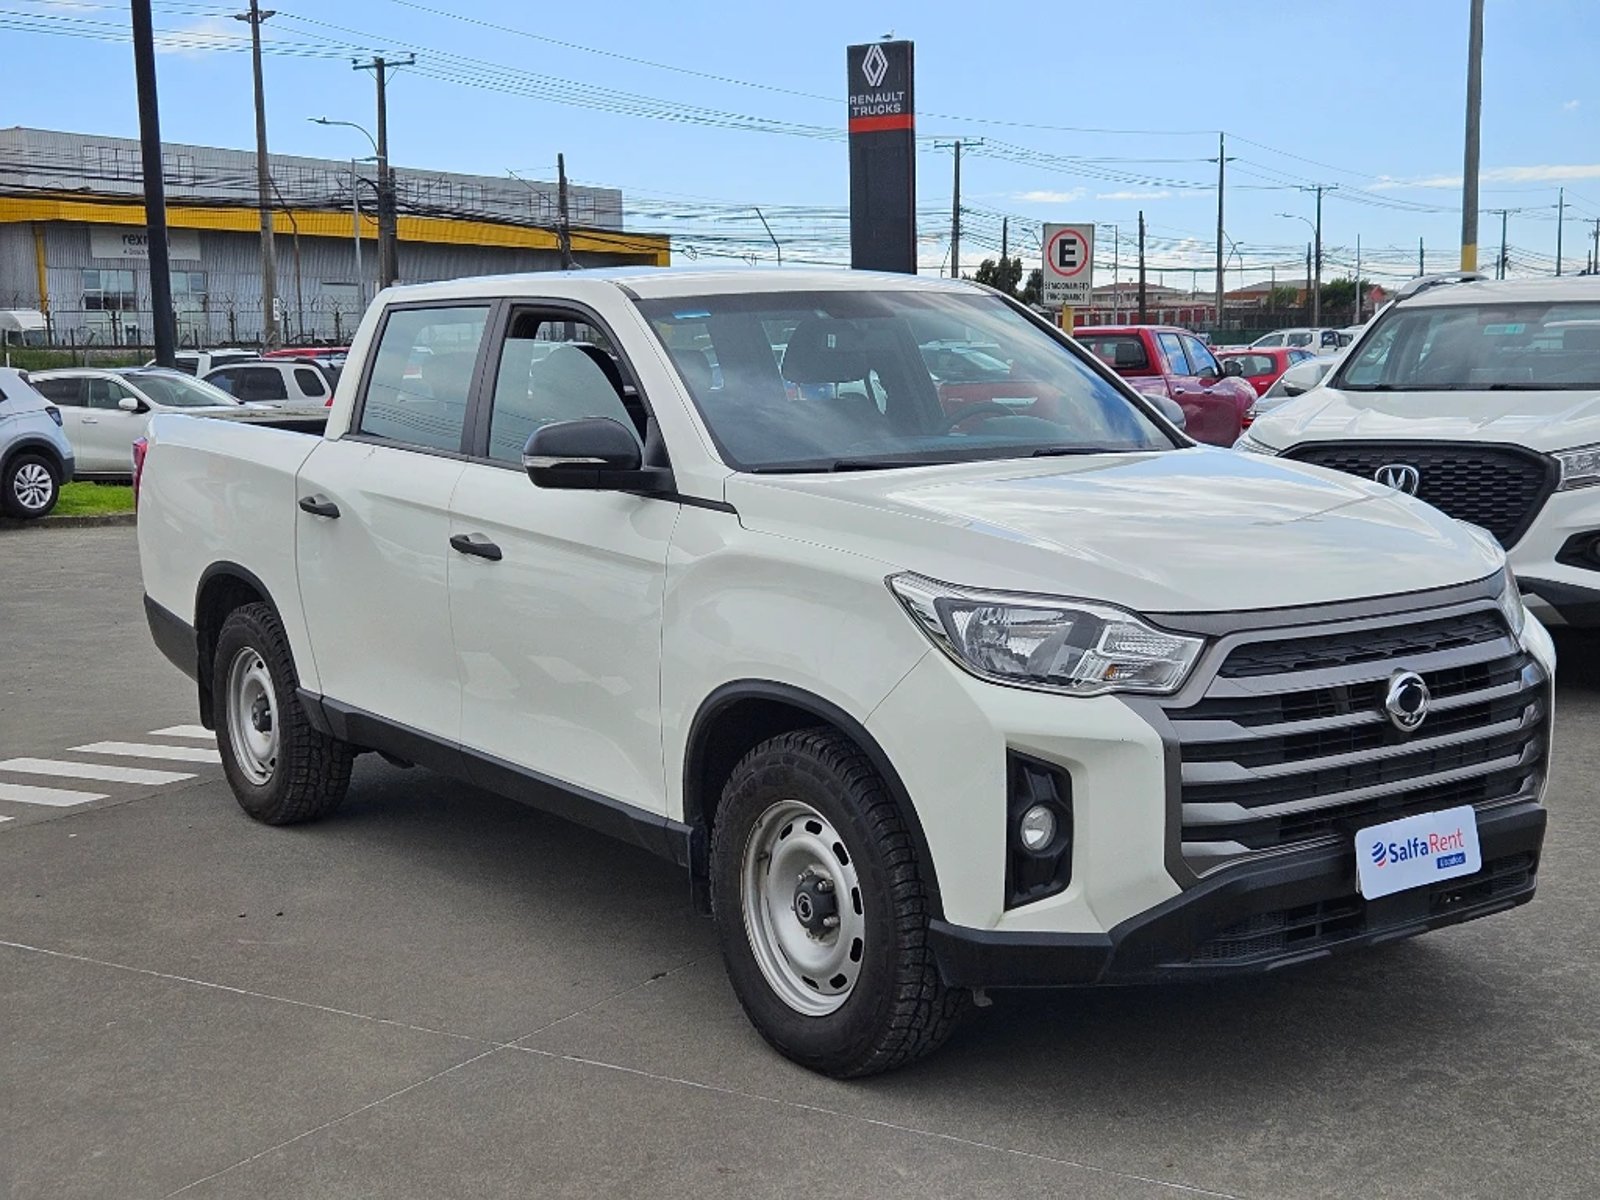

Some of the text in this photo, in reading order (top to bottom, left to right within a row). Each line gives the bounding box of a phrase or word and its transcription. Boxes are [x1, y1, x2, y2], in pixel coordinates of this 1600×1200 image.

[849, 91, 905, 105] RENAULT
[852, 103, 901, 116] TRUCKS
[1059, 239, 1077, 267] E
[1389, 828, 1464, 863] SalfaRent
